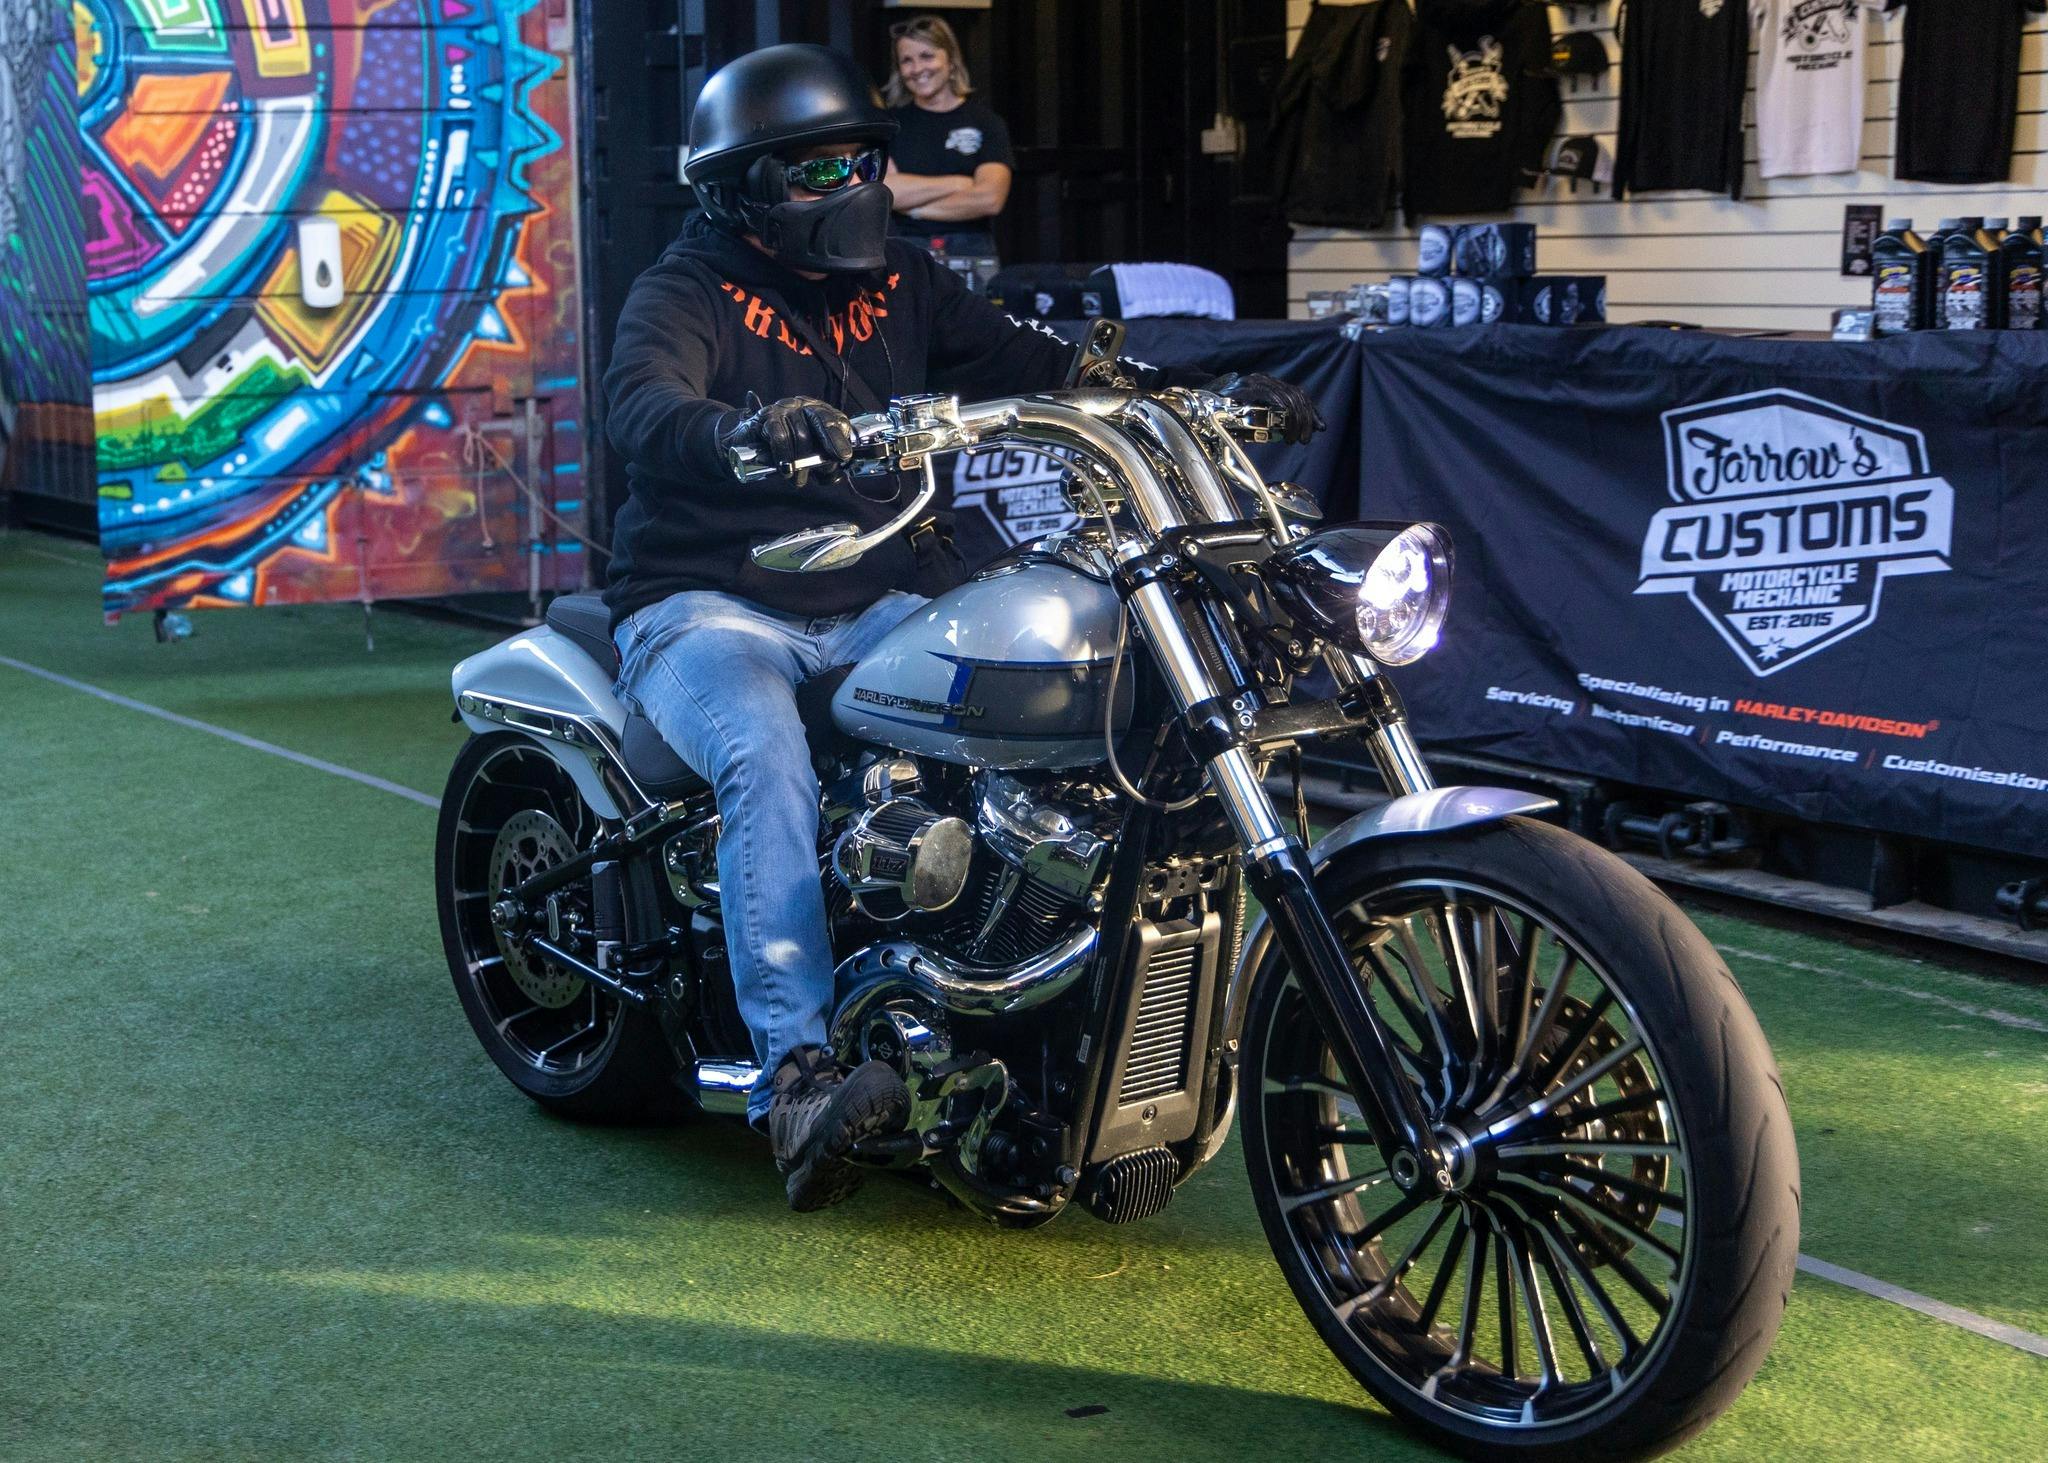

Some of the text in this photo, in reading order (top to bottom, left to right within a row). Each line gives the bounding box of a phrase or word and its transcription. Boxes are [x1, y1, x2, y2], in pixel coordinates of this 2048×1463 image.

[1660, 489, 1932, 562] CUSTOMS
[1720, 563, 1859, 592] MOTORCYCLE
[1732, 584, 1843, 610] MECHANIC
[1577, 673, 1707, 713] Specialising
[1709, 696, 1730, 712] in
[1486, 686, 1574, 716] Servicing
[1716, 730, 1859, 763] Performance
[1882, 754, 2048, 793] Customisation
